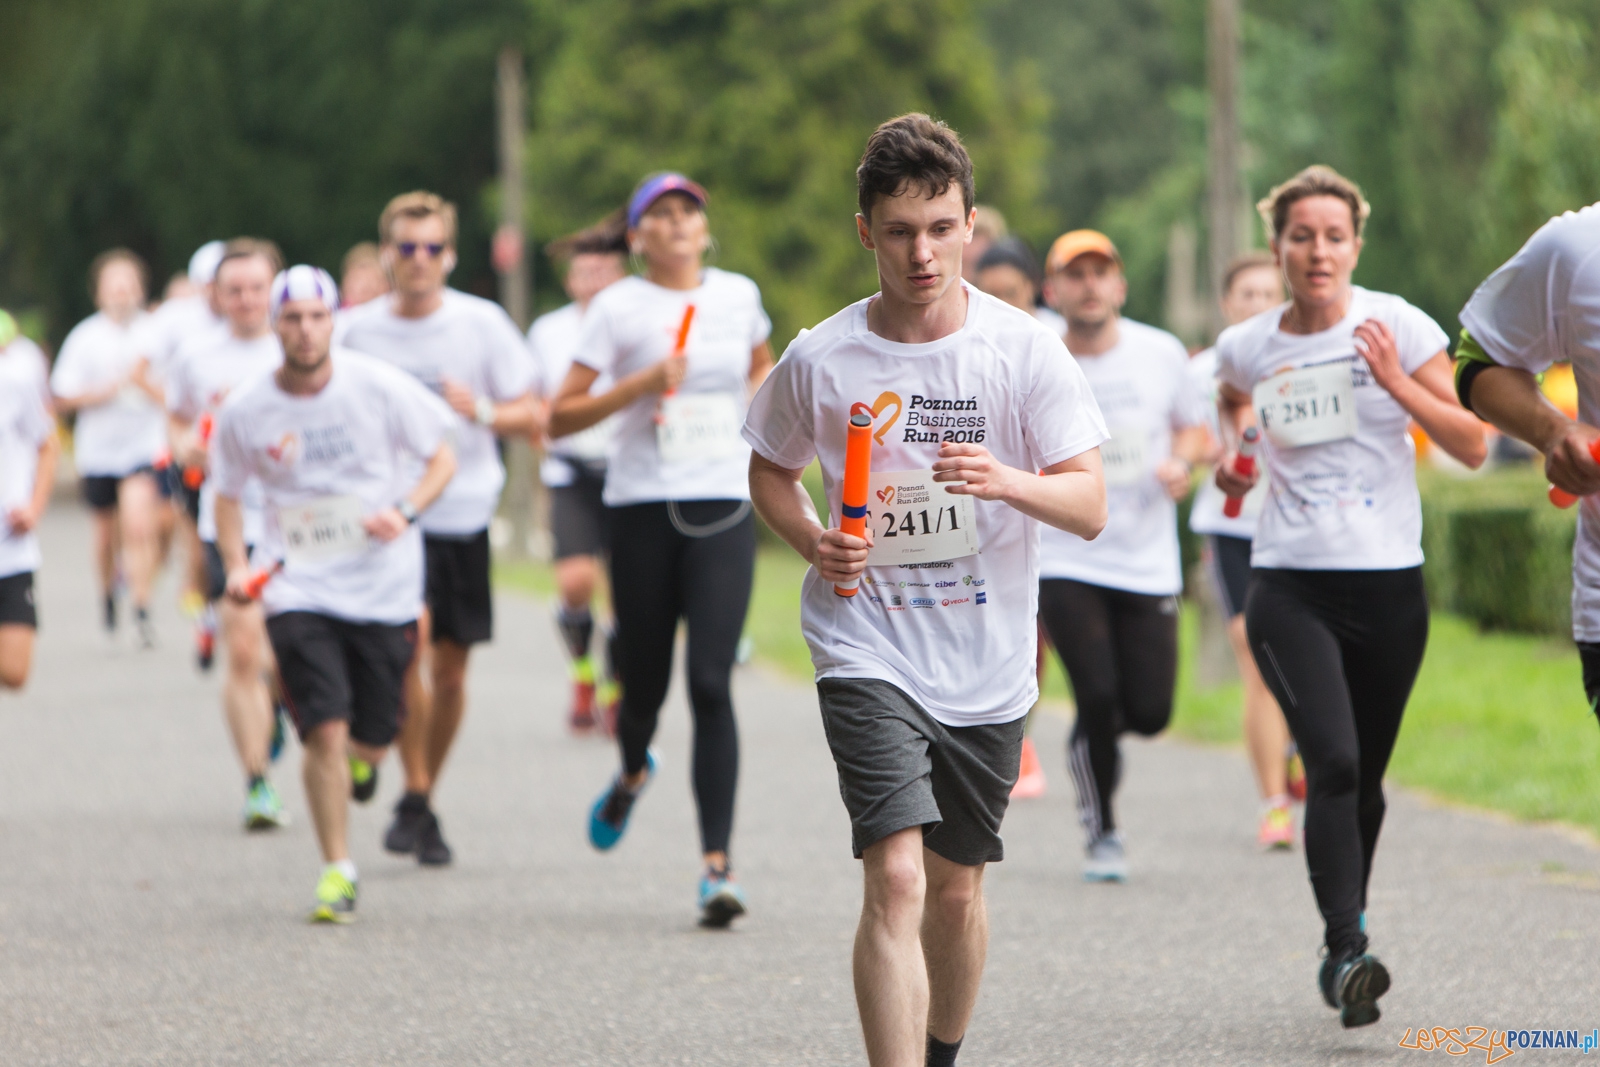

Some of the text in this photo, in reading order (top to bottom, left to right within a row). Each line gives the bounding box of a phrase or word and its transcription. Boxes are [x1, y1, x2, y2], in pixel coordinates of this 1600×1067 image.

[909, 395, 977, 410] Poznań
[1283, 393, 1340, 423] 281/1
[906, 412, 985, 427] Business
[903, 428, 985, 443] Run 2016
[881, 505, 961, 537] 241/1
[935, 580, 958, 588] ciber
